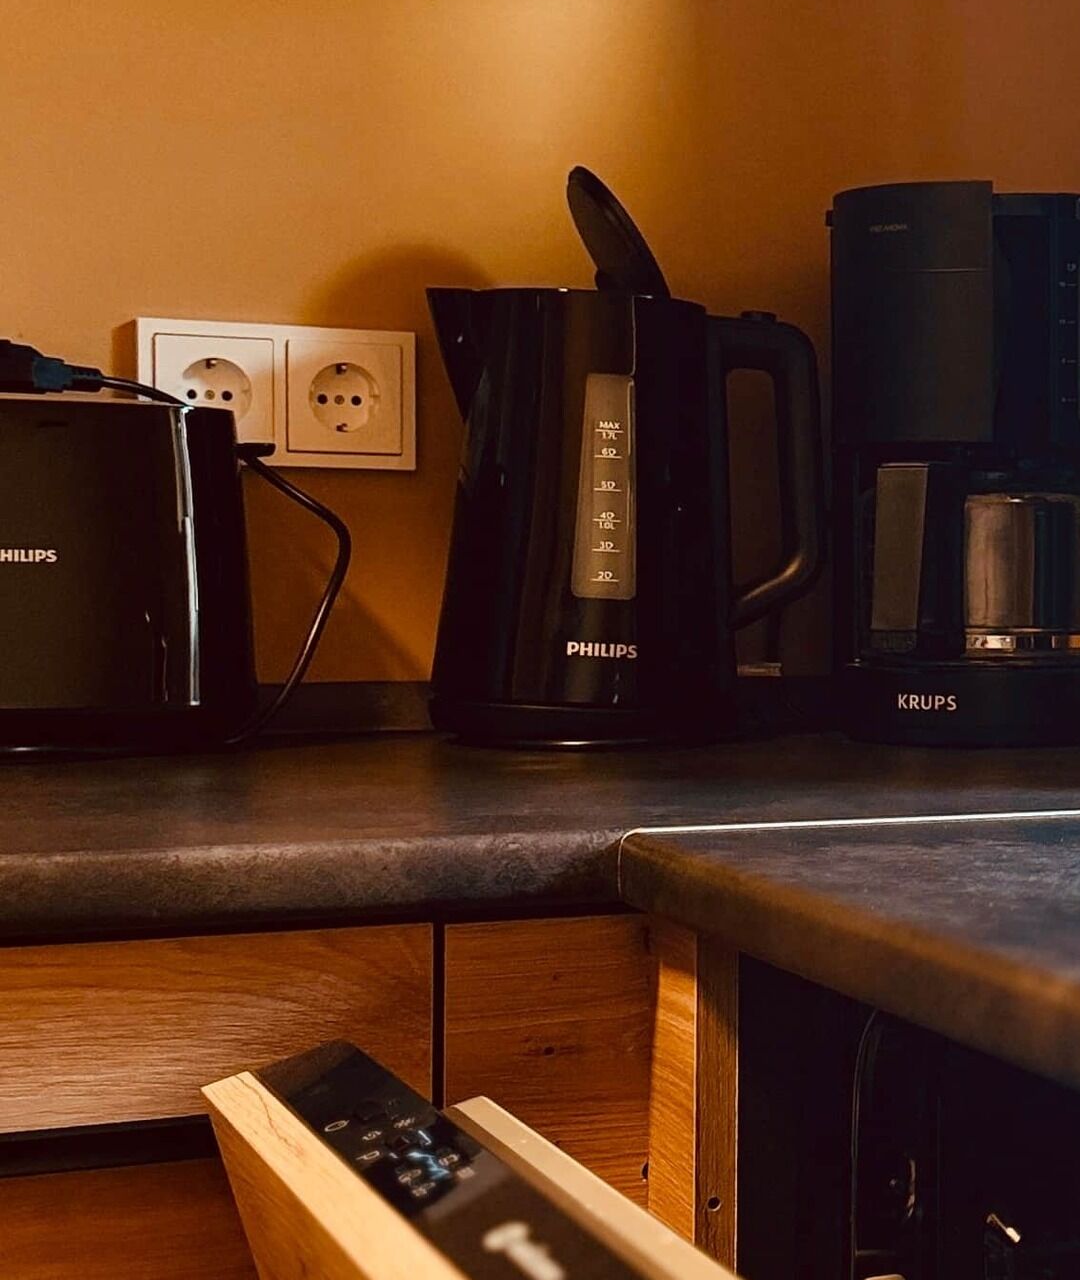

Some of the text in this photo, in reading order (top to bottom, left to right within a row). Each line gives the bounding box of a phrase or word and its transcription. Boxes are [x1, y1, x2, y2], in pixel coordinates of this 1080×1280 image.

[599, 420, 621, 430] MAX
[0, 549, 58, 563] HILIPS
[566, 641, 638, 659] PHILIPS
[898, 693, 957, 711] KRUPS
